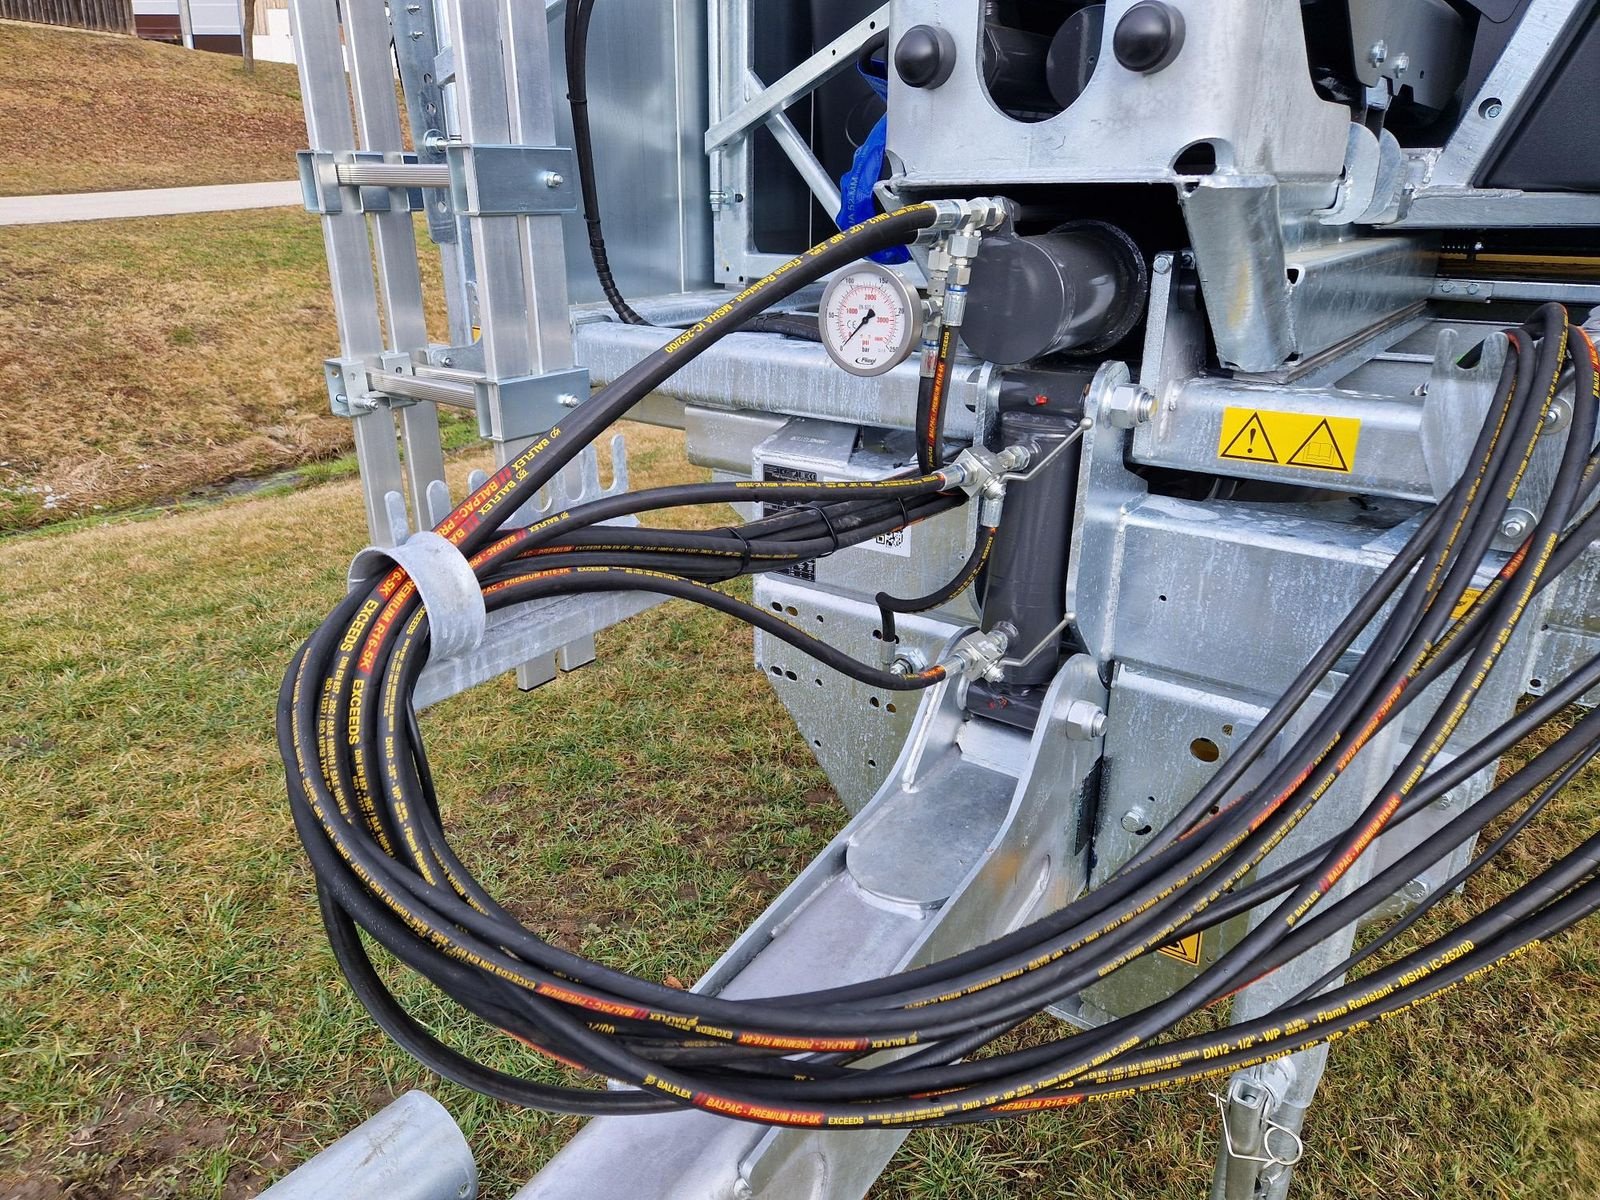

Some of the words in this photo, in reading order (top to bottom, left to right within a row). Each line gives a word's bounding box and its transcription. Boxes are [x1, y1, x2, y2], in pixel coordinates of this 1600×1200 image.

[829, 232, 845, 244] WP
[772, 256, 801, 276] Flame
[734, 271, 774, 302] Resistant
[703, 302, 732, 325] MSHA
[663, 321, 705, 355] IC-252/00
[930, 384, 940, 412] PREMIUM
[940, 331, 948, 358] EXCEEDS
[511, 437, 550, 471] BALFLEX
[457, 480, 498, 518] BALPAC
[477, 478, 516, 516] BALFLEX
[527, 514, 558, 533] BALFLEX
[485, 534, 517, 558] BALPAC
[378, 567, 407, 596] 16-5K
[503, 571, 540, 586] PREMIUM
[338, 598, 379, 654] EXCEEDS
[359, 622, 386, 669] R16-5K
[338, 655, 349, 669] DIN
[1406, 649, 1427, 678] BALFLEX
[323, 676, 333, 690] ISO
[334, 668, 344, 681] EN
[331, 680, 341, 693] 857
[319, 692, 330, 712] 11237
[327, 699, 337, 714] 2SC
[1379, 685, 1402, 715] BALPAC
[347, 678, 364, 745] EXCEEDS
[292, 710, 300, 745] Resistant
[326, 720, 334, 736] SAE
[1353, 716, 1381, 749] PREMIUM
[1293, 889, 1321, 917] BALFLEX
[1326, 853, 1353, 882] BALPAC
[1352, 819, 1381, 853] PREMIUM
[1399, 763, 1424, 794] EXCEEDS
[1470, 670, 1486, 689] DN10
[1490, 641, 1502, 654] WP
[1507, 605, 1523, 625] Flame
[1517, 579, 1536, 607] Resistant
[1531, 557, 1546, 578] MSHA
[295, 747, 305, 772] Flame
[326, 738, 335, 764] 100R16
[354, 749, 364, 763] DIN
[329, 770, 339, 786] SAE
[356, 764, 365, 776] EN
[358, 777, 368, 790] 857
[1310, 772, 1336, 801] EXCEEDS
[384, 736, 394, 758] DN10
[391, 785, 401, 800] WP
[403, 826, 420, 852] Flame
[313, 804, 324, 819] WP
[362, 796, 375, 812] 2SC
[369, 815, 382, 832] SAE
[1248, 799, 1281, 831] PREMIUM
[335, 841, 351, 859] DN6
[350, 860, 370, 882] 11237
[1233, 862, 1250, 879] DN10
[368, 880, 383, 895] ISO
[445, 873, 466, 895] MSHA
[1158, 887, 1173, 899] SAE
[1207, 890, 1219, 901] WP
[383, 895, 411, 919] 100R16
[411, 916, 429, 931] SAE
[1120, 911, 1134, 923] ISO
[1172, 911, 1191, 928] Flame
[431, 930, 449, 945] 2SC
[1146, 924, 1174, 947] Resistant
[453, 944, 467, 956] 857
[466, 951, 480, 963] EN
[1125, 944, 1145, 961] MSHA
[479, 958, 495, 971] DIN
[495, 966, 535, 988] EXCEEDS
[1001, 967, 1023, 981] Flame
[967, 975, 1001, 992] Resistant
[539, 985, 587, 1006] PREMIUM
[594, 1001, 634, 1016] BALPAC
[1087, 1071, 1097, 1079] EN
[1127, 1063, 1140, 1071] SAE
[1202, 1041, 1230, 1060] DN12
[1236, 1034, 1256, 1049] 1/2"
[1263, 1027, 1281, 1041] WP
[1316, 1004, 1347, 1023] Flame
[1347, 982, 1393, 1010] Resistant
[1398, 963, 1430, 987] MSHA
[1429, 938, 1475, 970] IC-252/00
[649, 1012, 686, 1024] BALFLEX
[1044, 1096, 1080, 1106] R16-5K
[1087, 1088, 1136, 1102] EXCEEDS
[1150, 1081, 1159, 1089] EN
[1325, 1029, 1344, 1042] WP
[1380, 1002, 1411, 1020] Flame
[1411, 981, 1457, 1008] Resistant
[1464, 962, 1494, 983] MSHA
[1495, 938, 1541, 967] IC-252/00
[694, 1023, 732, 1039] EXCEEDS
[739, 1034, 771, 1045] R16-6K
[770, 1039, 813, 1048] PREMIUM
[818, 1040, 855, 1048] BALPAC
[872, 1037, 905, 1047] BALFLEX
[656, 1079, 691, 1098] BALFLEX
[705, 1097, 742, 1113] BALPAC
[749, 1107, 788, 1121] PREMIUM
[790, 1113, 819, 1123] R16-6K
[828, 1116, 863, 1124] EXCEEDS
[962, 1099, 980, 1109] DN10
[985, 1095, 998, 1104] 3/8"
[1003, 1090, 1016, 1099] WP
[1037, 1076, 1058, 1088] Flame
[1058, 1062, 1088, 1081] Resistant
[1091, 1051, 1112, 1066] MSHA
[1110, 1035, 1140, 1056] IC-252/00
[1107, 1073, 1123, 1081] 11237
[1156, 1063, 1171, 1071] TYPE
